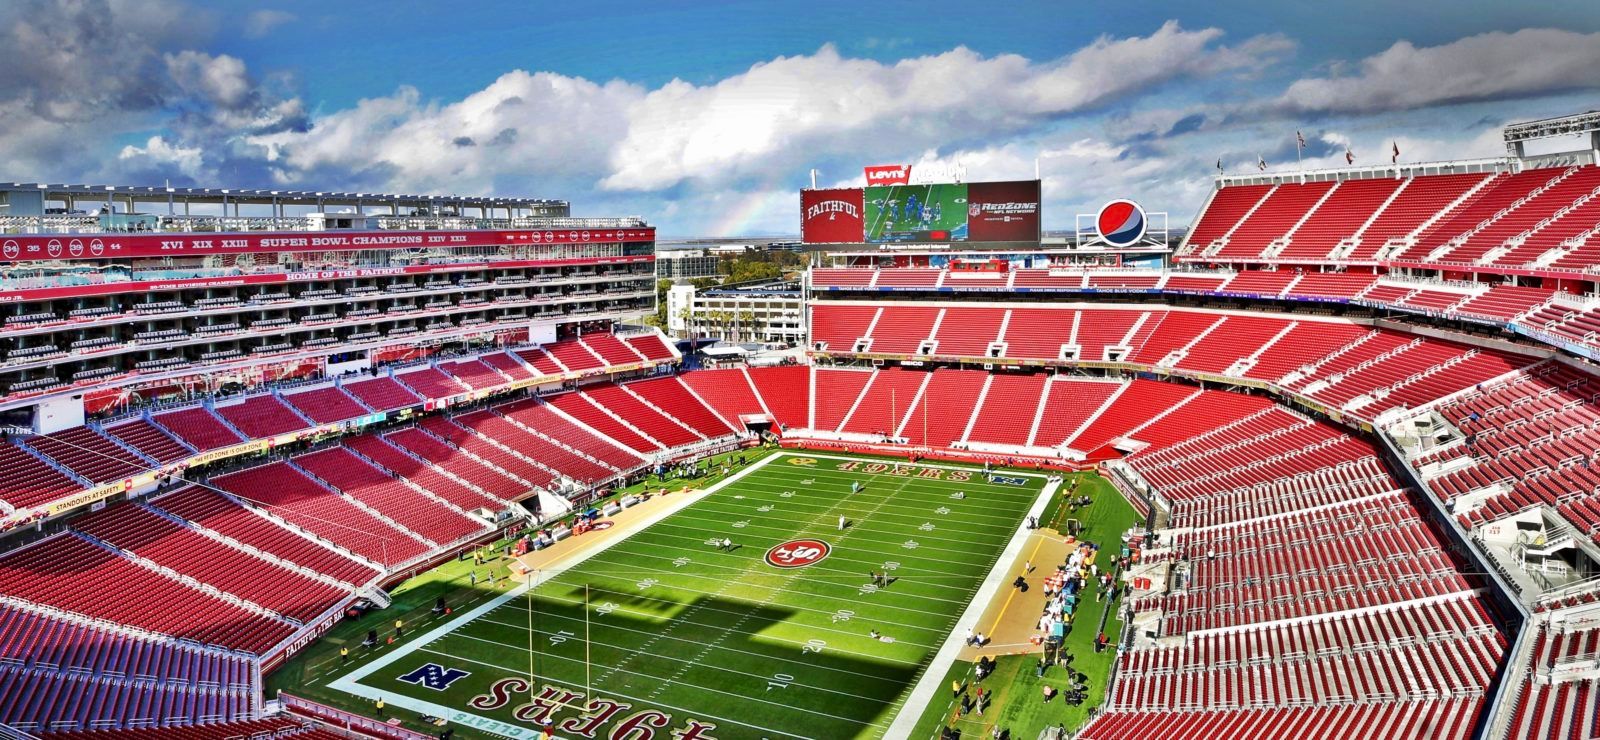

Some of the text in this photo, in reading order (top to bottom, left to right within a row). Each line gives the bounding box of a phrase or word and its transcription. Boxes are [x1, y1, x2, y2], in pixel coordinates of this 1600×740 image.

[808, 200, 859, 220] FAITHFUL
[4, 245, 18, 253] 34
[161, 241, 184, 250] XVI
[192, 240, 213, 249] XIX
[221, 239, 249, 248] XXIII
[260, 238, 308, 247] SUPER
[312, 237, 350, 246] BOWL
[352, 235, 423, 245] CHAMPIONS
[428, 235, 446, 243] XXIV
[286, 272, 319, 280] HOME
[361, 268, 406, 276] FAITHFUL
[214, 450, 229, 459] ZONE
[248, 442, 262, 450] ZONE
[836, 461, 973, 481] 49ERS
[56, 495, 91, 511] STANDOUTS
[99, 485, 119, 497] SAFETY
[285, 628, 318, 658] FAITHFUL
[321, 617, 333, 632] THE
[333, 608, 345, 624] BAY
[452, 713, 524, 737] CLEATS
